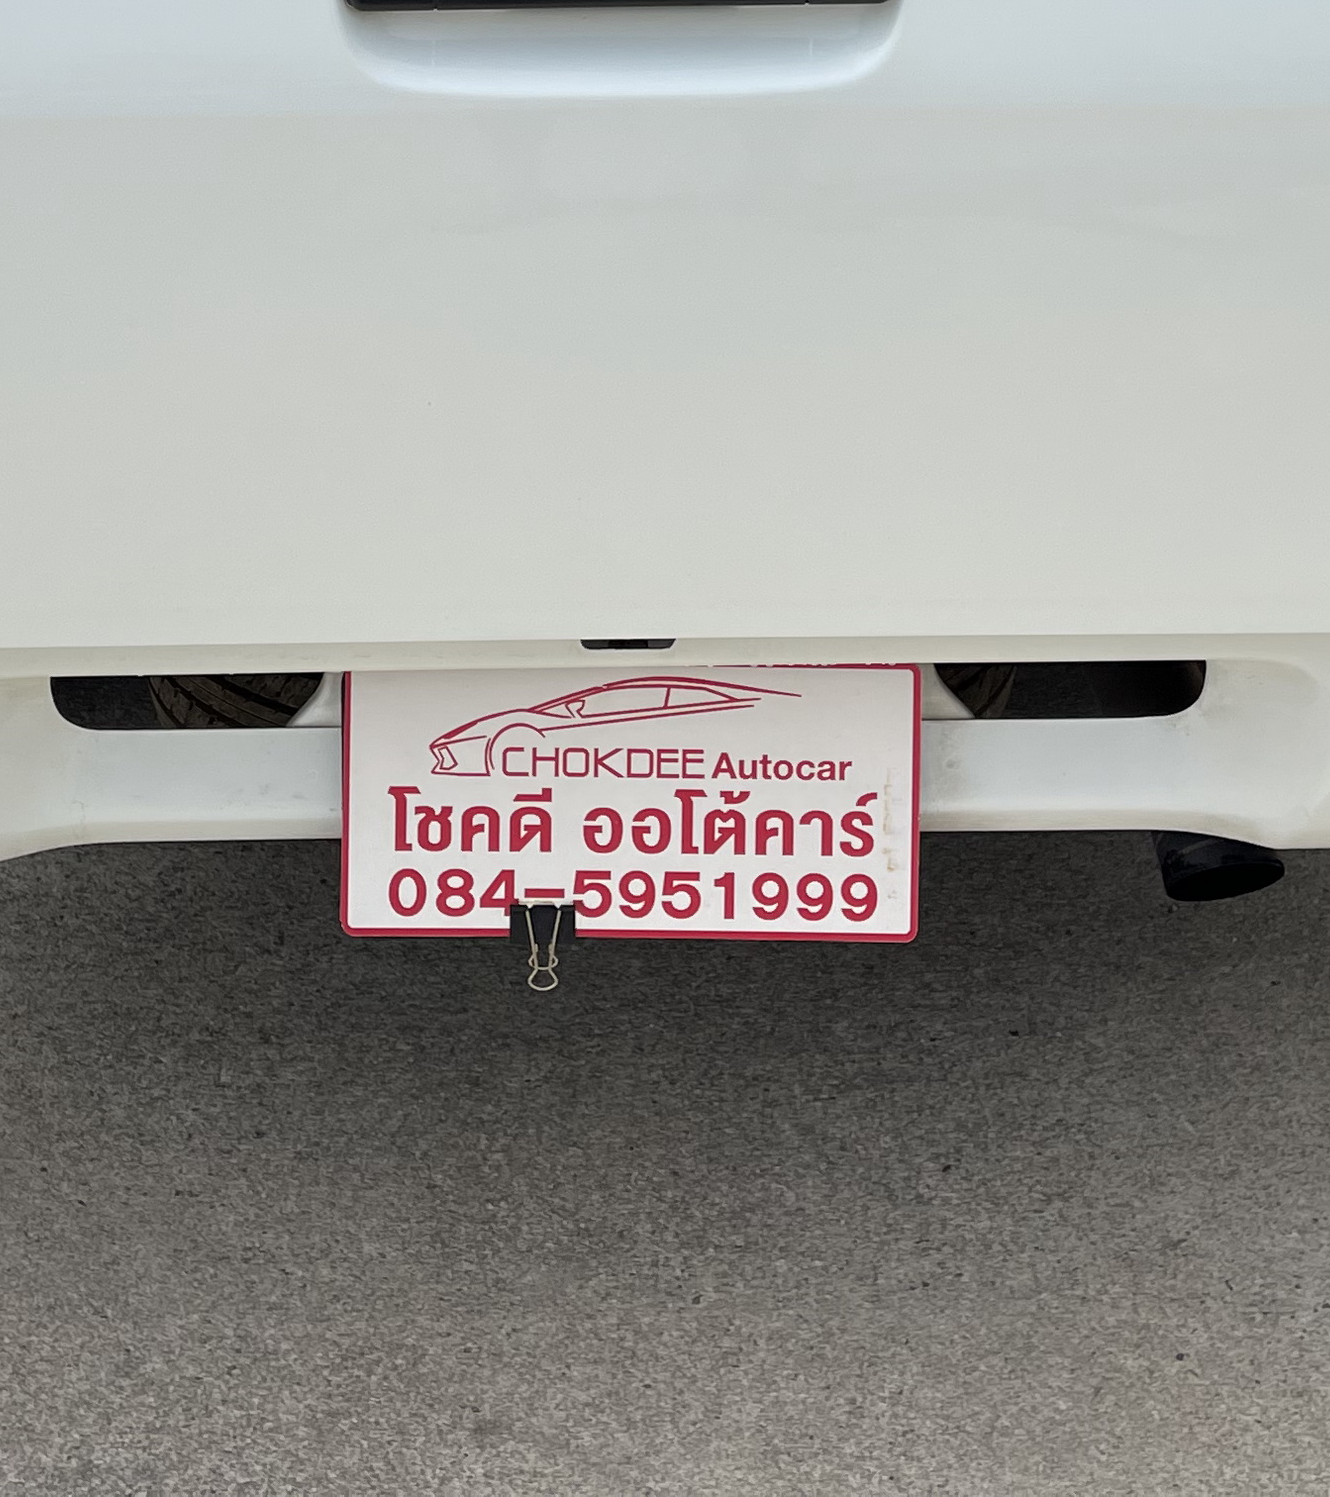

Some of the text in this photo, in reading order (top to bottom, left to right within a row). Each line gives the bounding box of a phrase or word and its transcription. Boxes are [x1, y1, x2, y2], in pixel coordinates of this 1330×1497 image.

[501, 746, 853, 781] CHOKDEE Autocar
[387, 785, 879, 857] โชคดี ออโต้คาร์
[388, 867, 879, 921] 084-5951999
